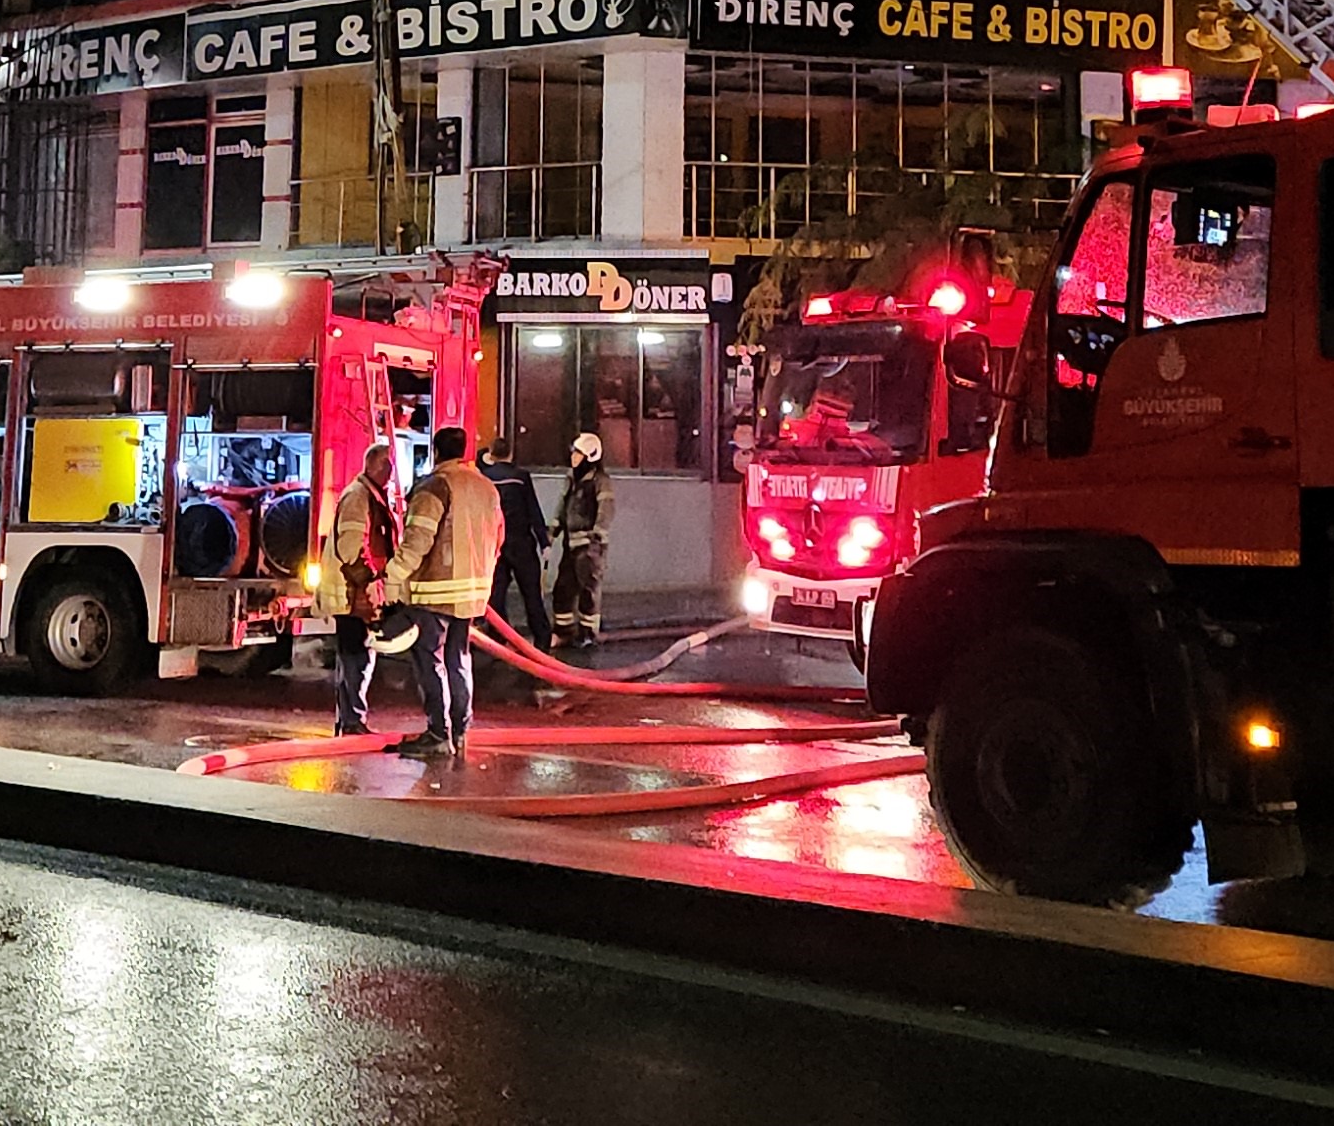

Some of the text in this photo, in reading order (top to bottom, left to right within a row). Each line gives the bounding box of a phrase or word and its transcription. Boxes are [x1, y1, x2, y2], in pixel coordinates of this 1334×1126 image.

[194, 21, 317, 73] CAFE
[335, 14, 372, 56] &
[987, 4, 1012, 42] &
[1025, 0, 1157, 51] BİSTRO
